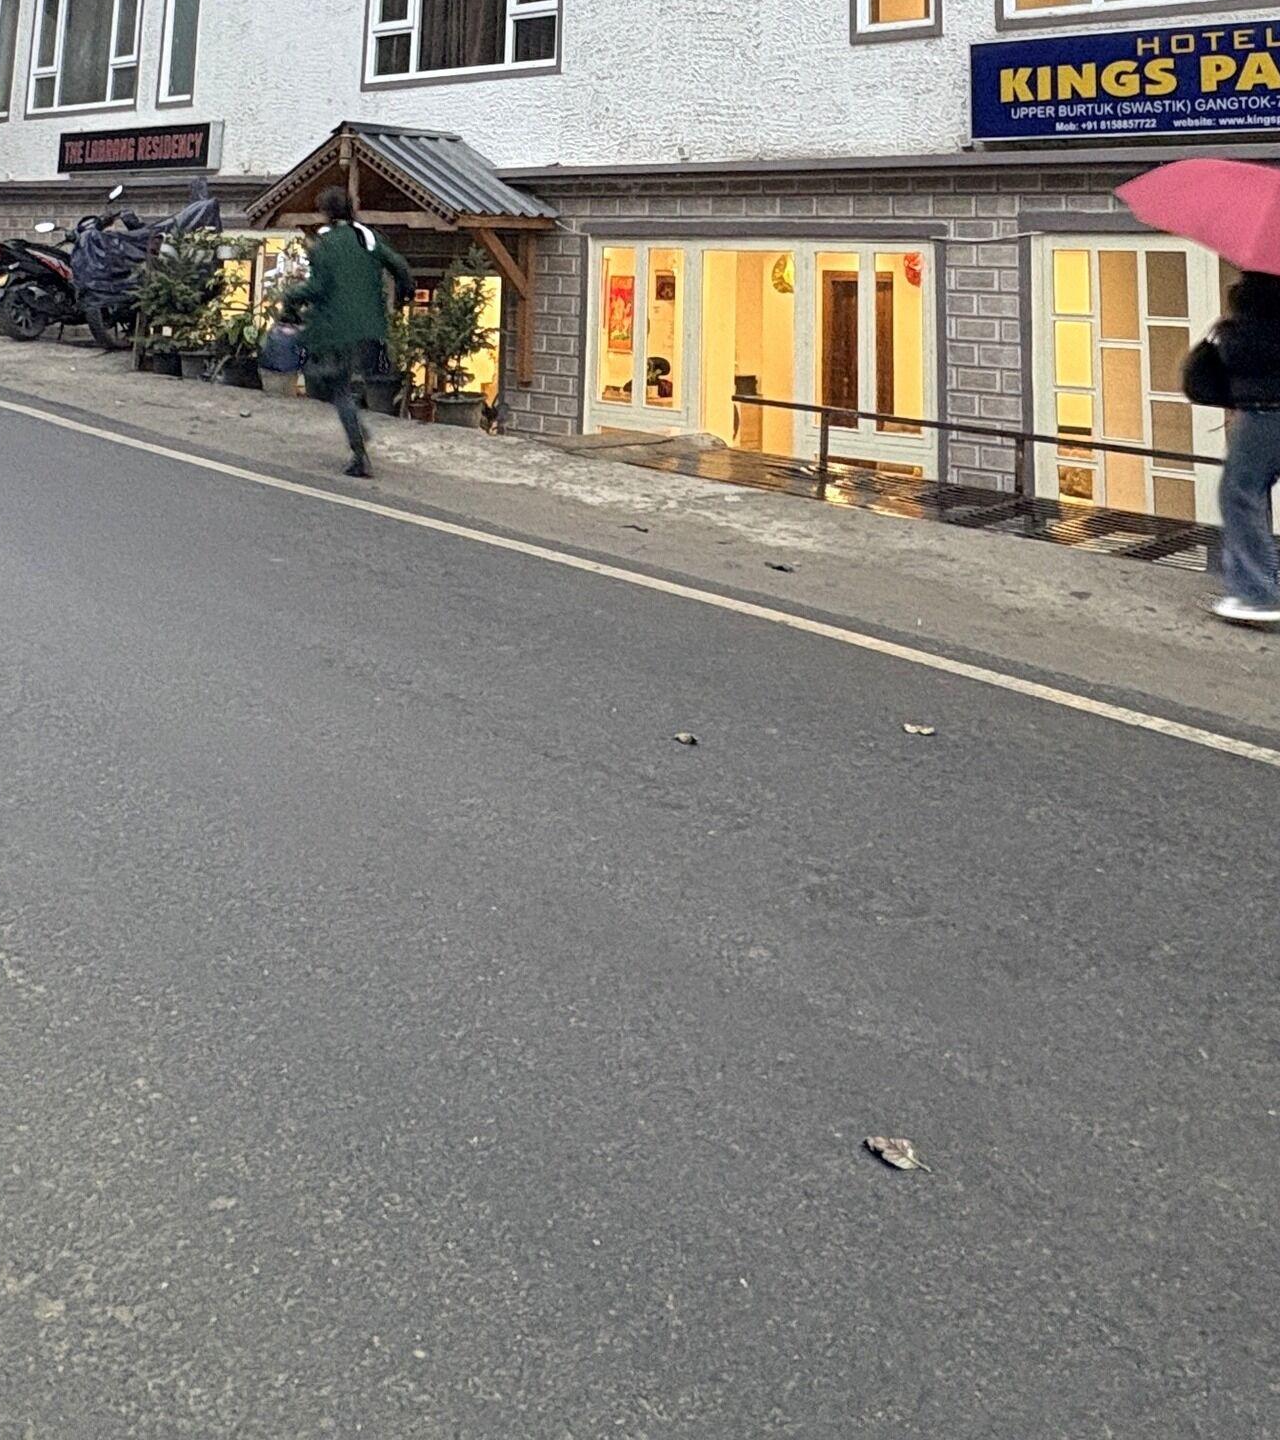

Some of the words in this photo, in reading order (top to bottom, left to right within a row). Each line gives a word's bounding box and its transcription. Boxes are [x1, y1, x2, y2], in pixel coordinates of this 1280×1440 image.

[999, 57, 1178, 103] KINGS
[1011, 105, 1056, 119] UPPER
[1058, 103, 1114, 118] BURTUK
[1117, 98, 1192, 116] (SWASTIK)
[1055, 121, 1079, 131] Mob:
[1081, 121, 1098, 130] +91
[64, 141, 84, 164] THE
[136, 132, 204, 161] RESIDENCY
